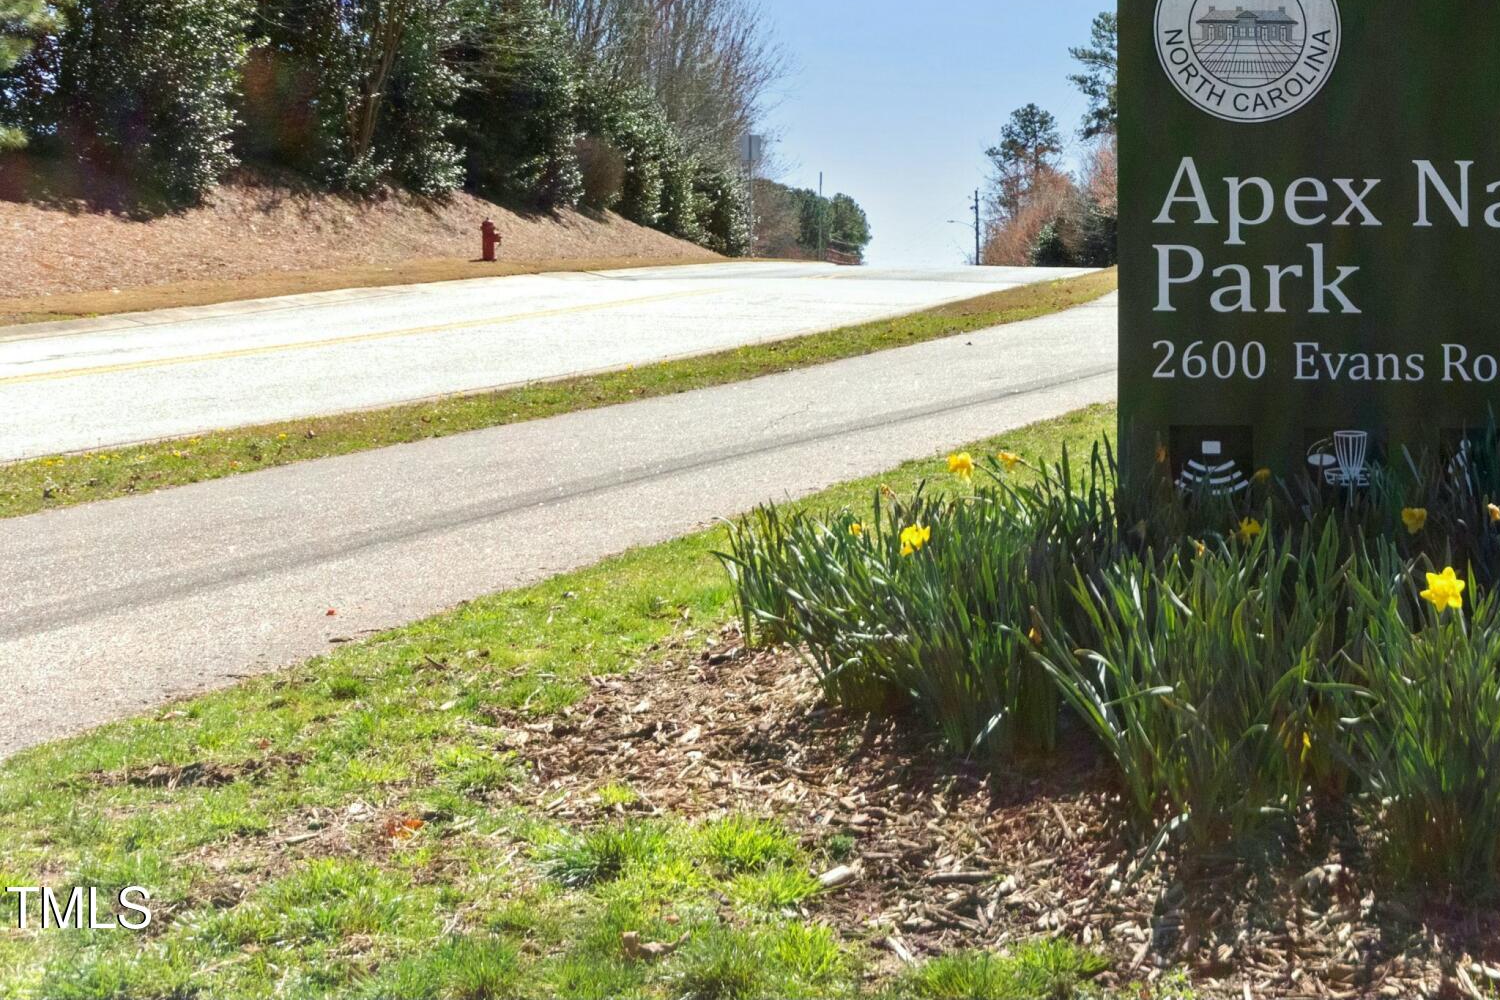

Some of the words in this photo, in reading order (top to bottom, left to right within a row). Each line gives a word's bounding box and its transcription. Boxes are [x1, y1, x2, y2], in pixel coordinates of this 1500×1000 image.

[1164, 28, 1226, 106] NORTH
[1232, 29, 1331, 112] CAROLINA
[1151, 156, 1382, 245] Apex
[1151, 243, 1362, 313] Park
[1151, 340, 1266, 379] 2600
[1293, 342, 1425, 381] Evans
